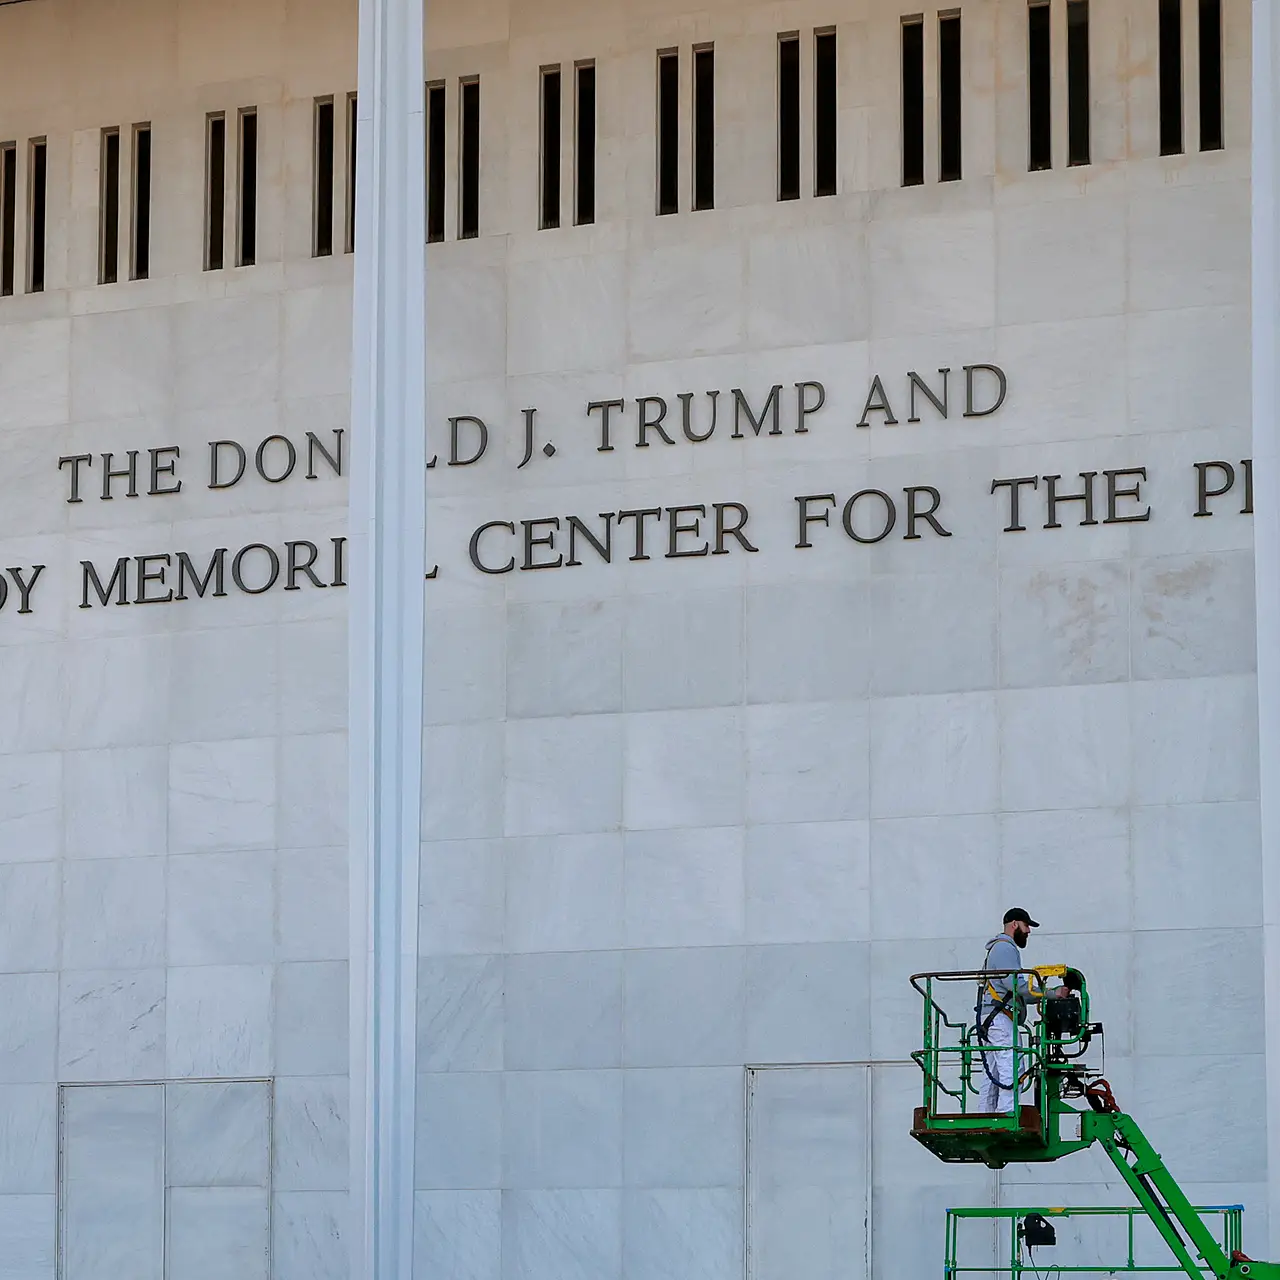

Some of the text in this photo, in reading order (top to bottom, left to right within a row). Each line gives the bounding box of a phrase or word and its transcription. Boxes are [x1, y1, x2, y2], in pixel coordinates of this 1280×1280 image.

[59, 364, 1007, 503] THE DOND J. TRUMP AND
[79, 537, 438, 609] MEMORI
[469, 502, 759, 574] CENTER
[794, 486, 952, 549] FOR
[991, 467, 1151, 532] THE
